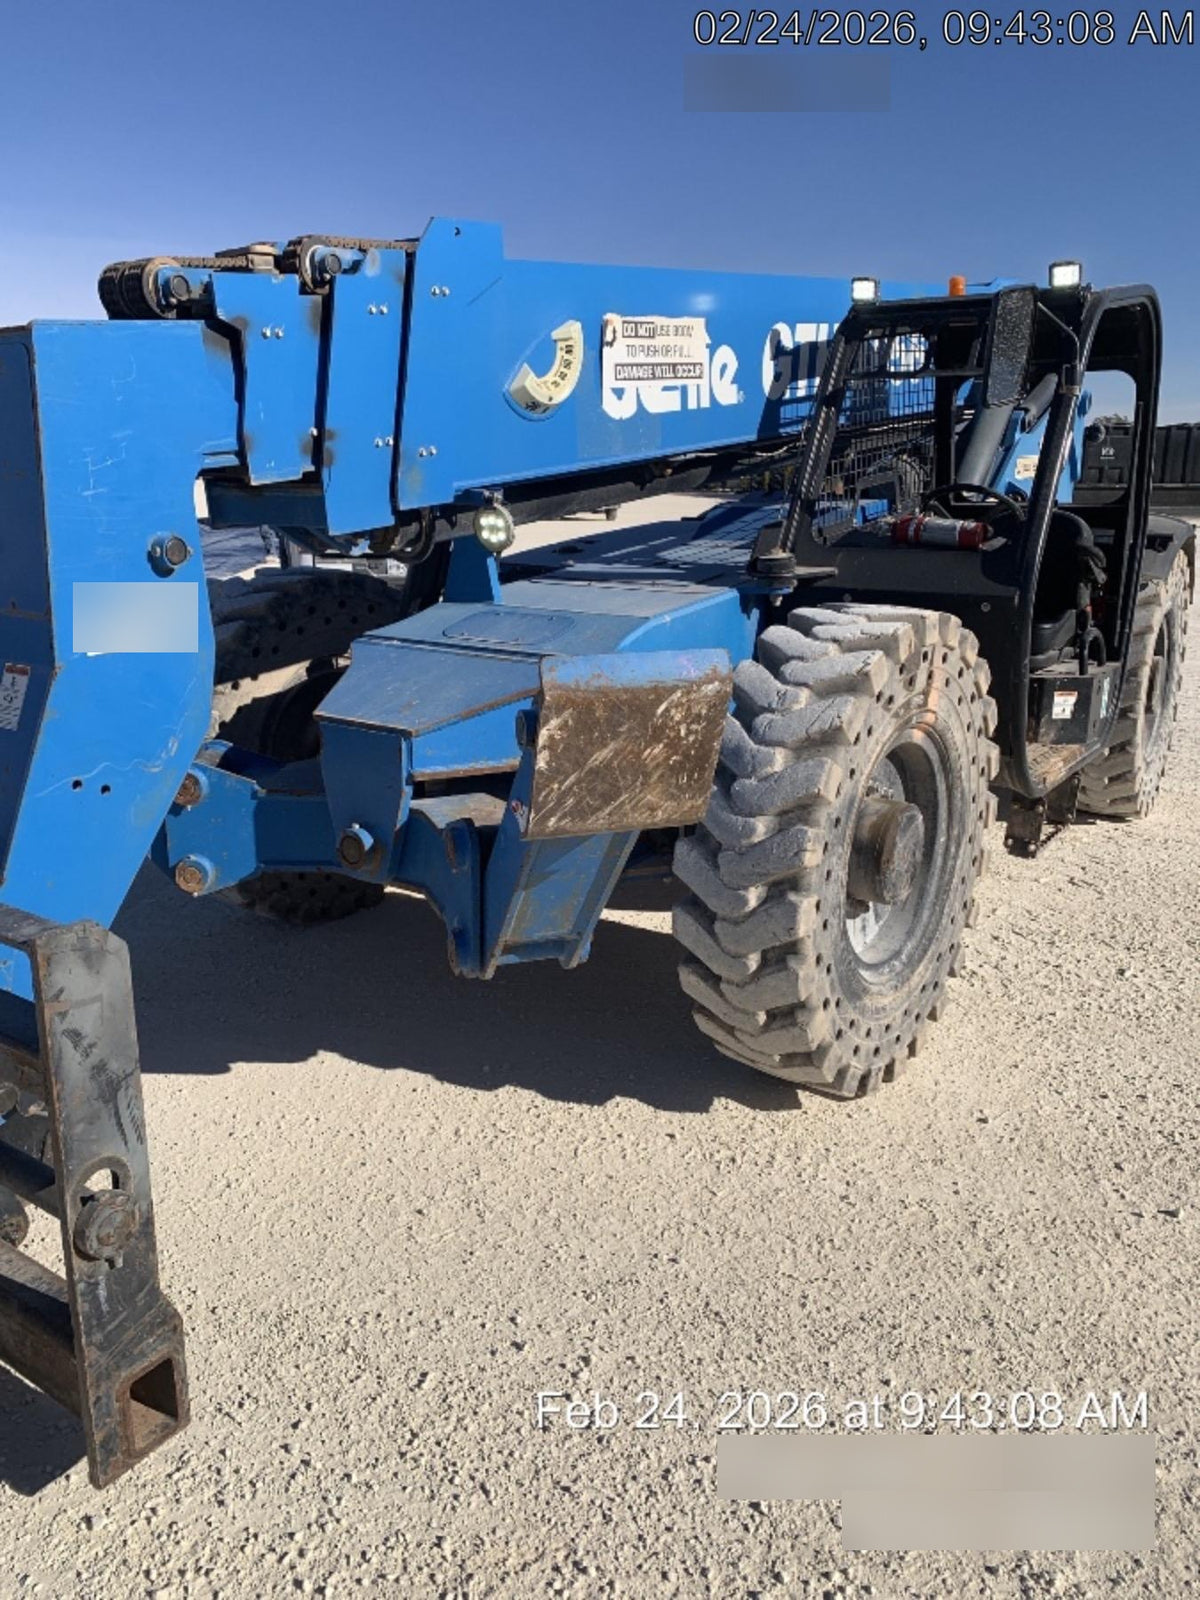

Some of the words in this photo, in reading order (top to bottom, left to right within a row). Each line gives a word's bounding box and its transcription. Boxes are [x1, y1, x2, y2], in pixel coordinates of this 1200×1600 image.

[623, 322, 636, 337] DO
[637, 322, 654, 337] NOT
[626, 344, 637, 358] TO
[638, 344, 660, 358] PUSH
[616, 365, 653, 379] DAMAGE
[654, 364, 675, 378] WILL
